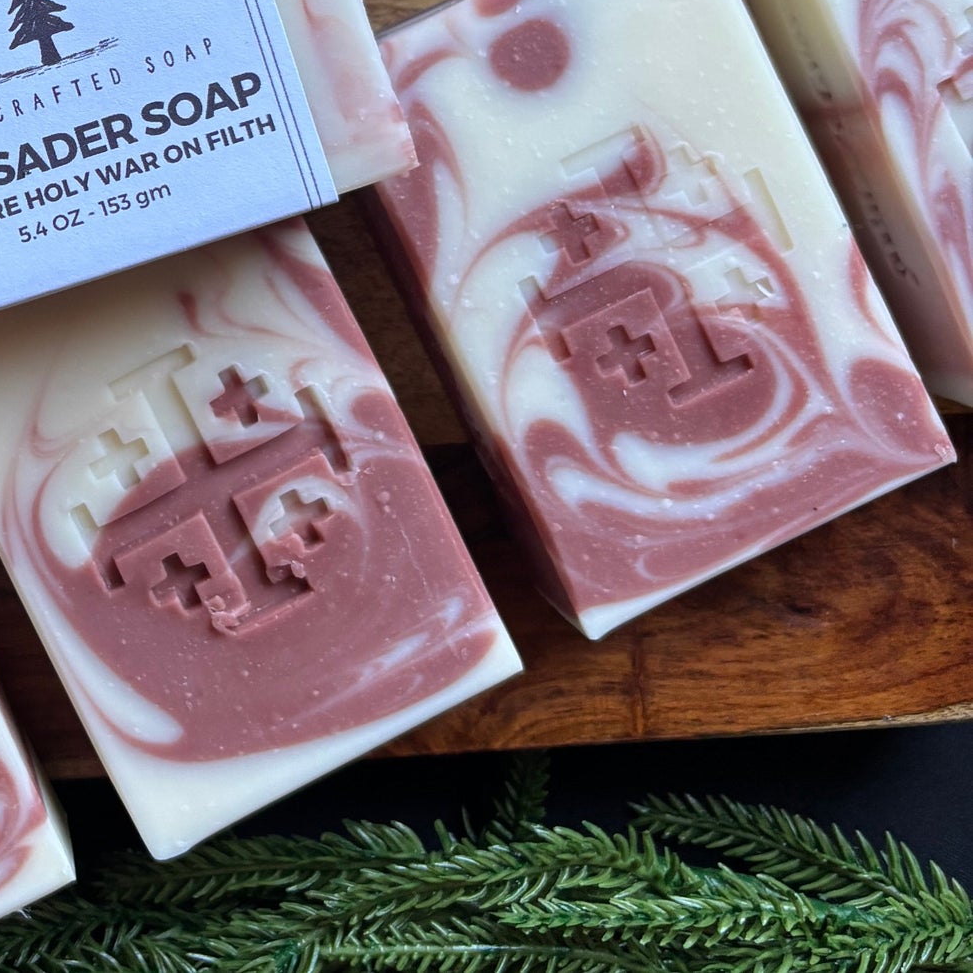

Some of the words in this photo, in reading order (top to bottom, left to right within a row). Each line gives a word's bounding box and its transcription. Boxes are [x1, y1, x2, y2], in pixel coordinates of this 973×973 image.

[145, 37, 213, 74] SOAP
[140, 72, 262, 136] SOAP
[24, 171, 91, 210] HOLY
[94, 152, 161, 186] WAR
[163, 137, 203, 164] ON
[205, 113, 277, 152] FILTH
[17, 221, 48, 243] 5.4
[52, 208, 85, 231] OZ
[97, 193, 131, 217] 153
[135, 184, 172, 209] gm
